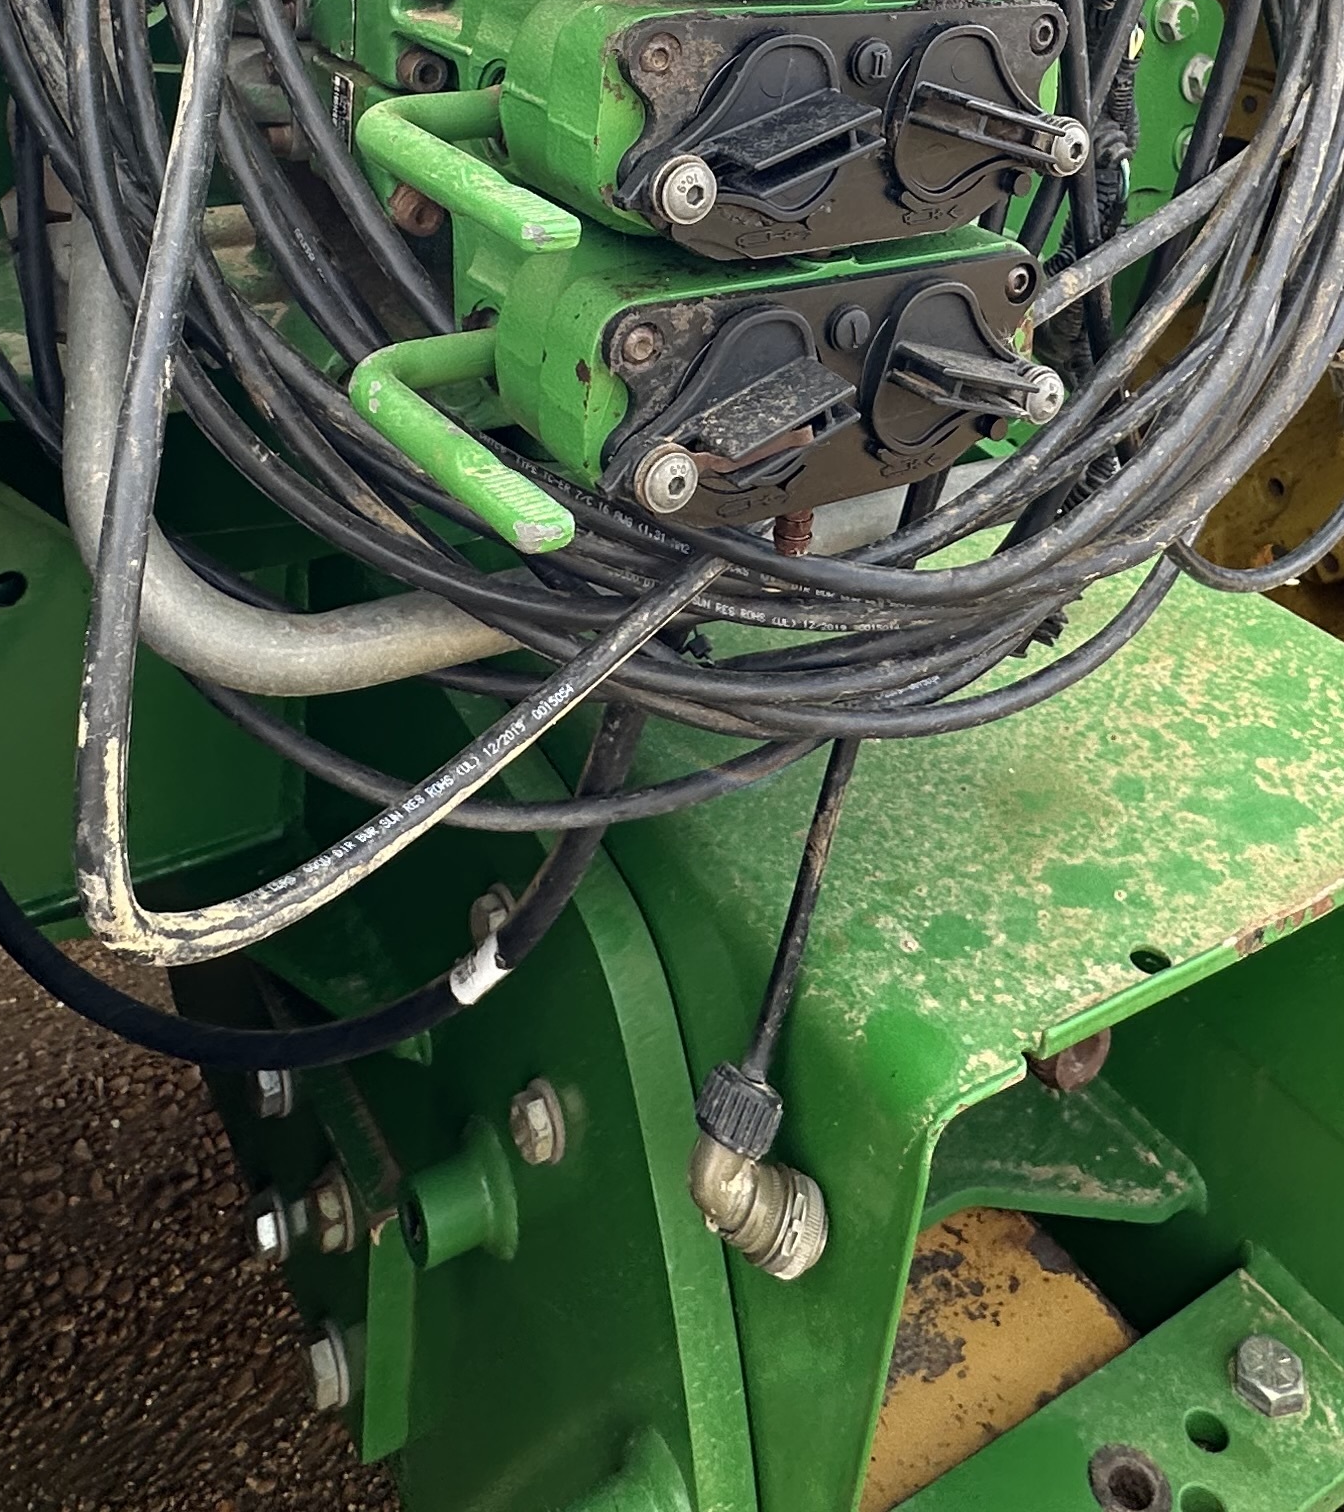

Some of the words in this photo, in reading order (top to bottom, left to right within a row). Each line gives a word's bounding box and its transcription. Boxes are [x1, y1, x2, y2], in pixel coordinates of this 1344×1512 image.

[714, 602, 736, 618] RES
[378, 810, 405, 831] SUN
[402, 793, 426, 814] RES
[482, 720, 527, 758] 12/2019
